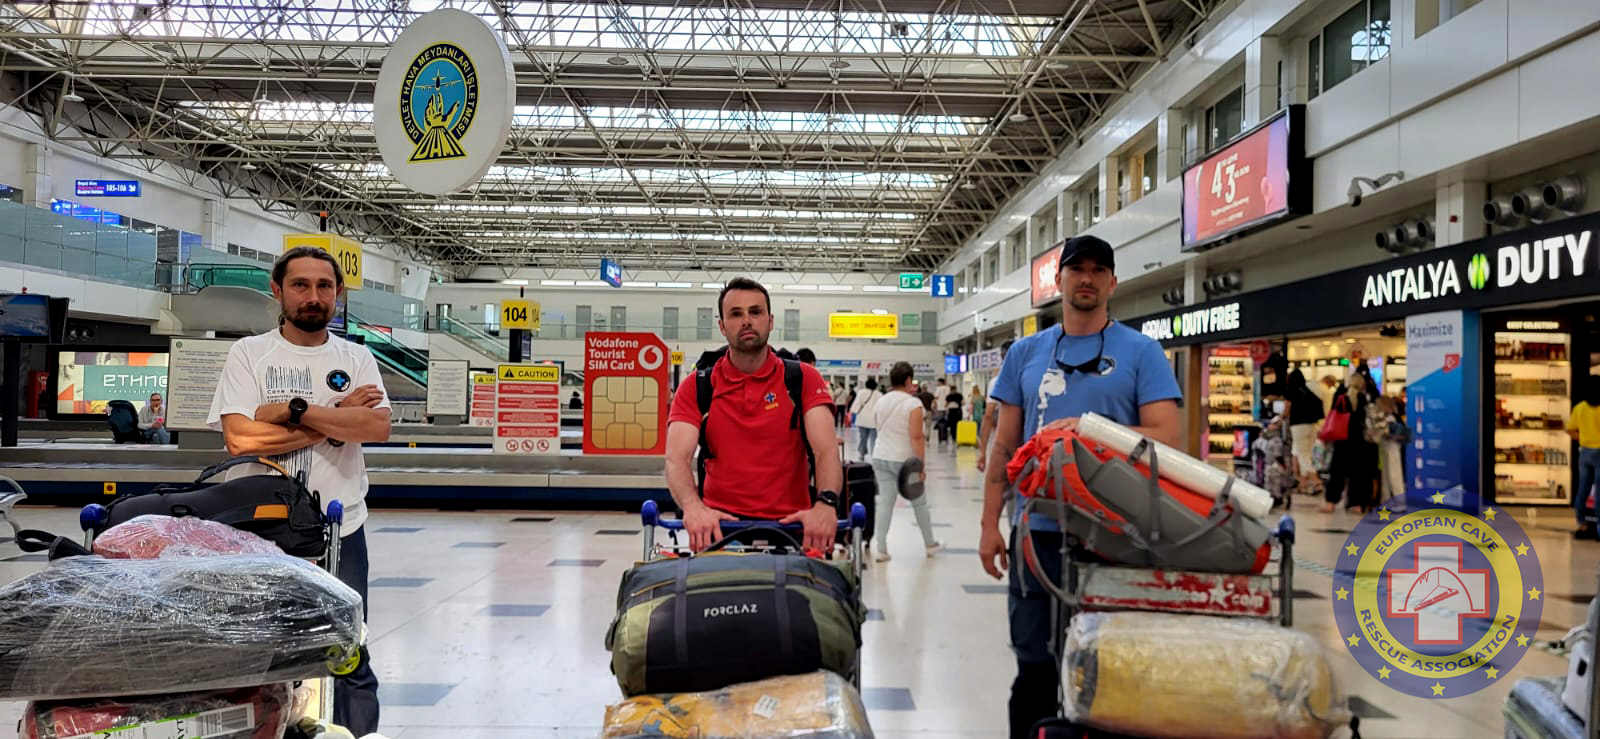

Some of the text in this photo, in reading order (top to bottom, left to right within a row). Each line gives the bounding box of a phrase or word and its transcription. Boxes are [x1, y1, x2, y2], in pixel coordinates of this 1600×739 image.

[418, 46, 471, 75] MEYDANLARI
[403, 65, 420, 95] HAVA
[402, 99, 419, 140] DEVLET
[338, 249, 358, 277] 103
[1362, 230, 1592, 308] ANTALYA DUTY
[504, 307, 527, 322] 104
[1182, 308, 1210, 337] DUTY
[1210, 302, 1240, 332] FREE
[1408, 320, 1454, 338] Maximize
[588, 337, 639, 349] Vodafone
[588, 348, 626, 360] Tourist
[518, 370, 554, 378] CAUTION
[588, 360, 635, 371] SIM Card
[703, 603, 758, 619] FORCLAZ
